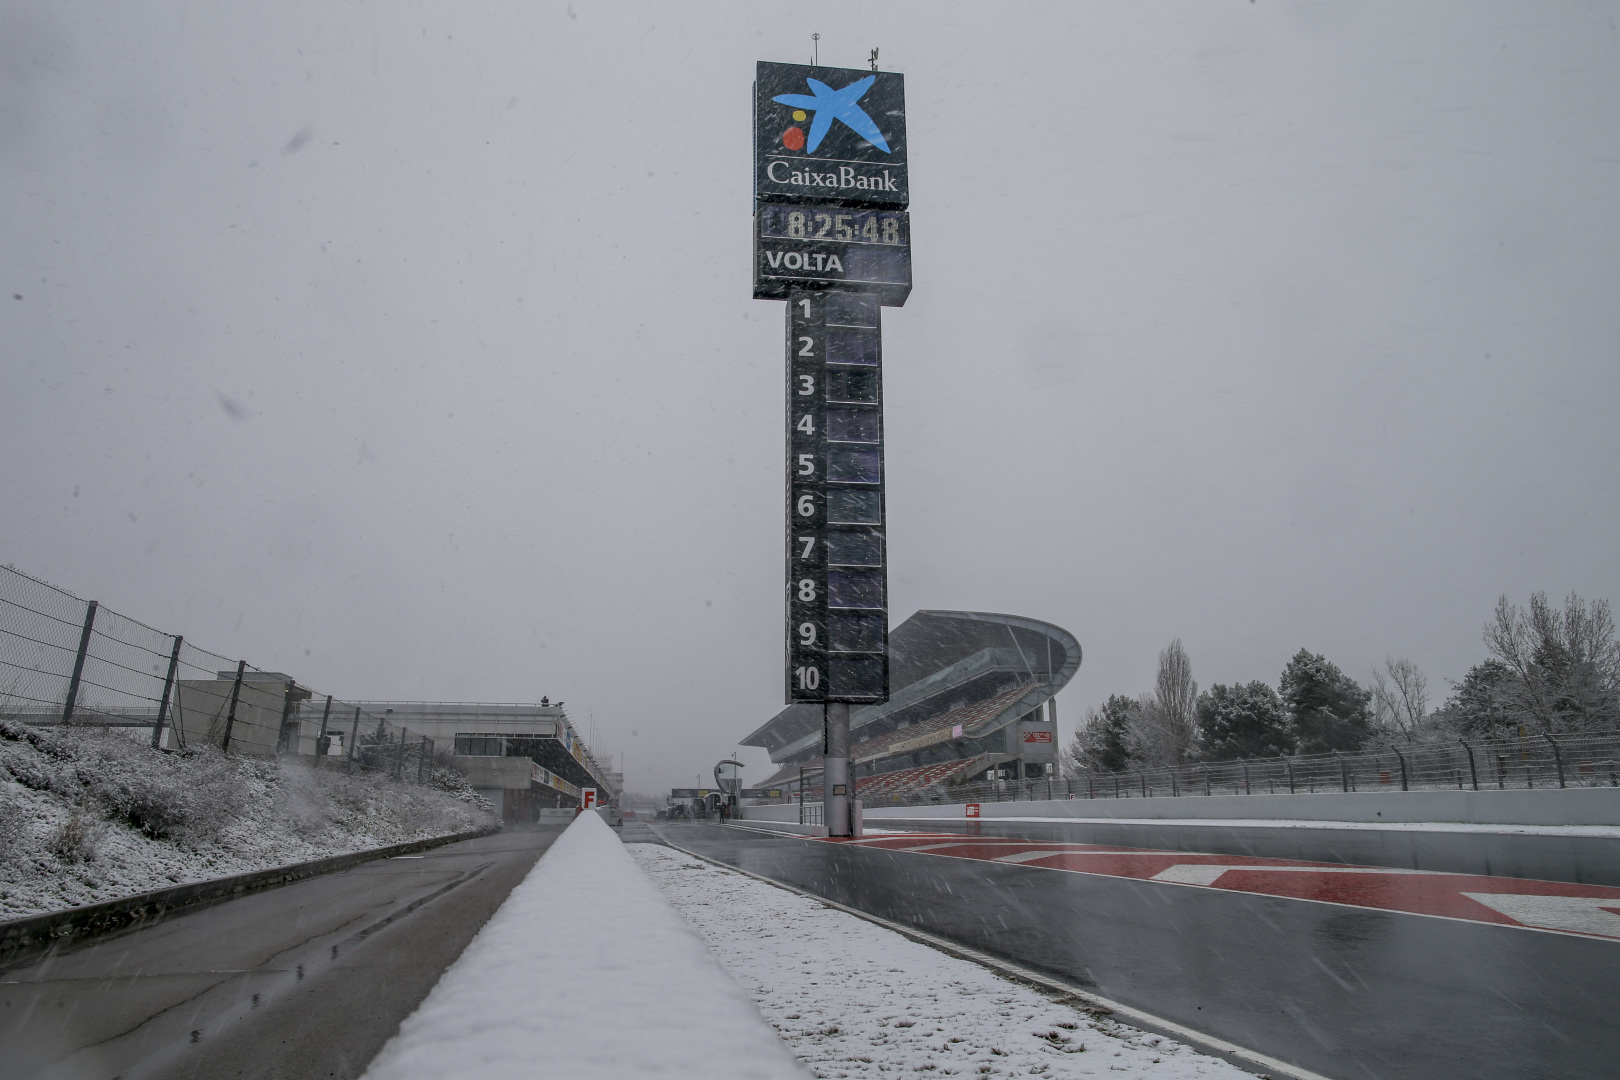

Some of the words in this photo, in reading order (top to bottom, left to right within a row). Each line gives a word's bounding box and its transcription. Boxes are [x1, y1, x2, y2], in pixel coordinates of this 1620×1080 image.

[767, 161, 899, 192] CaixaBank
[788, 211, 899, 245] 8:25:48
[765, 250, 844, 272] VOLTA
[798, 298, 811, 318] 1
[798, 336, 814, 357] 2
[798, 374, 815, 396] 3
[797, 414, 816, 435] 4
[798, 454, 815, 476] 5
[797, 495, 815, 517] 6
[798, 536, 816, 559] 7
[798, 578, 816, 602] 8
[799, 622, 817, 646] 9
[795, 666, 820, 690] 10
[584, 791, 595, 809] F
